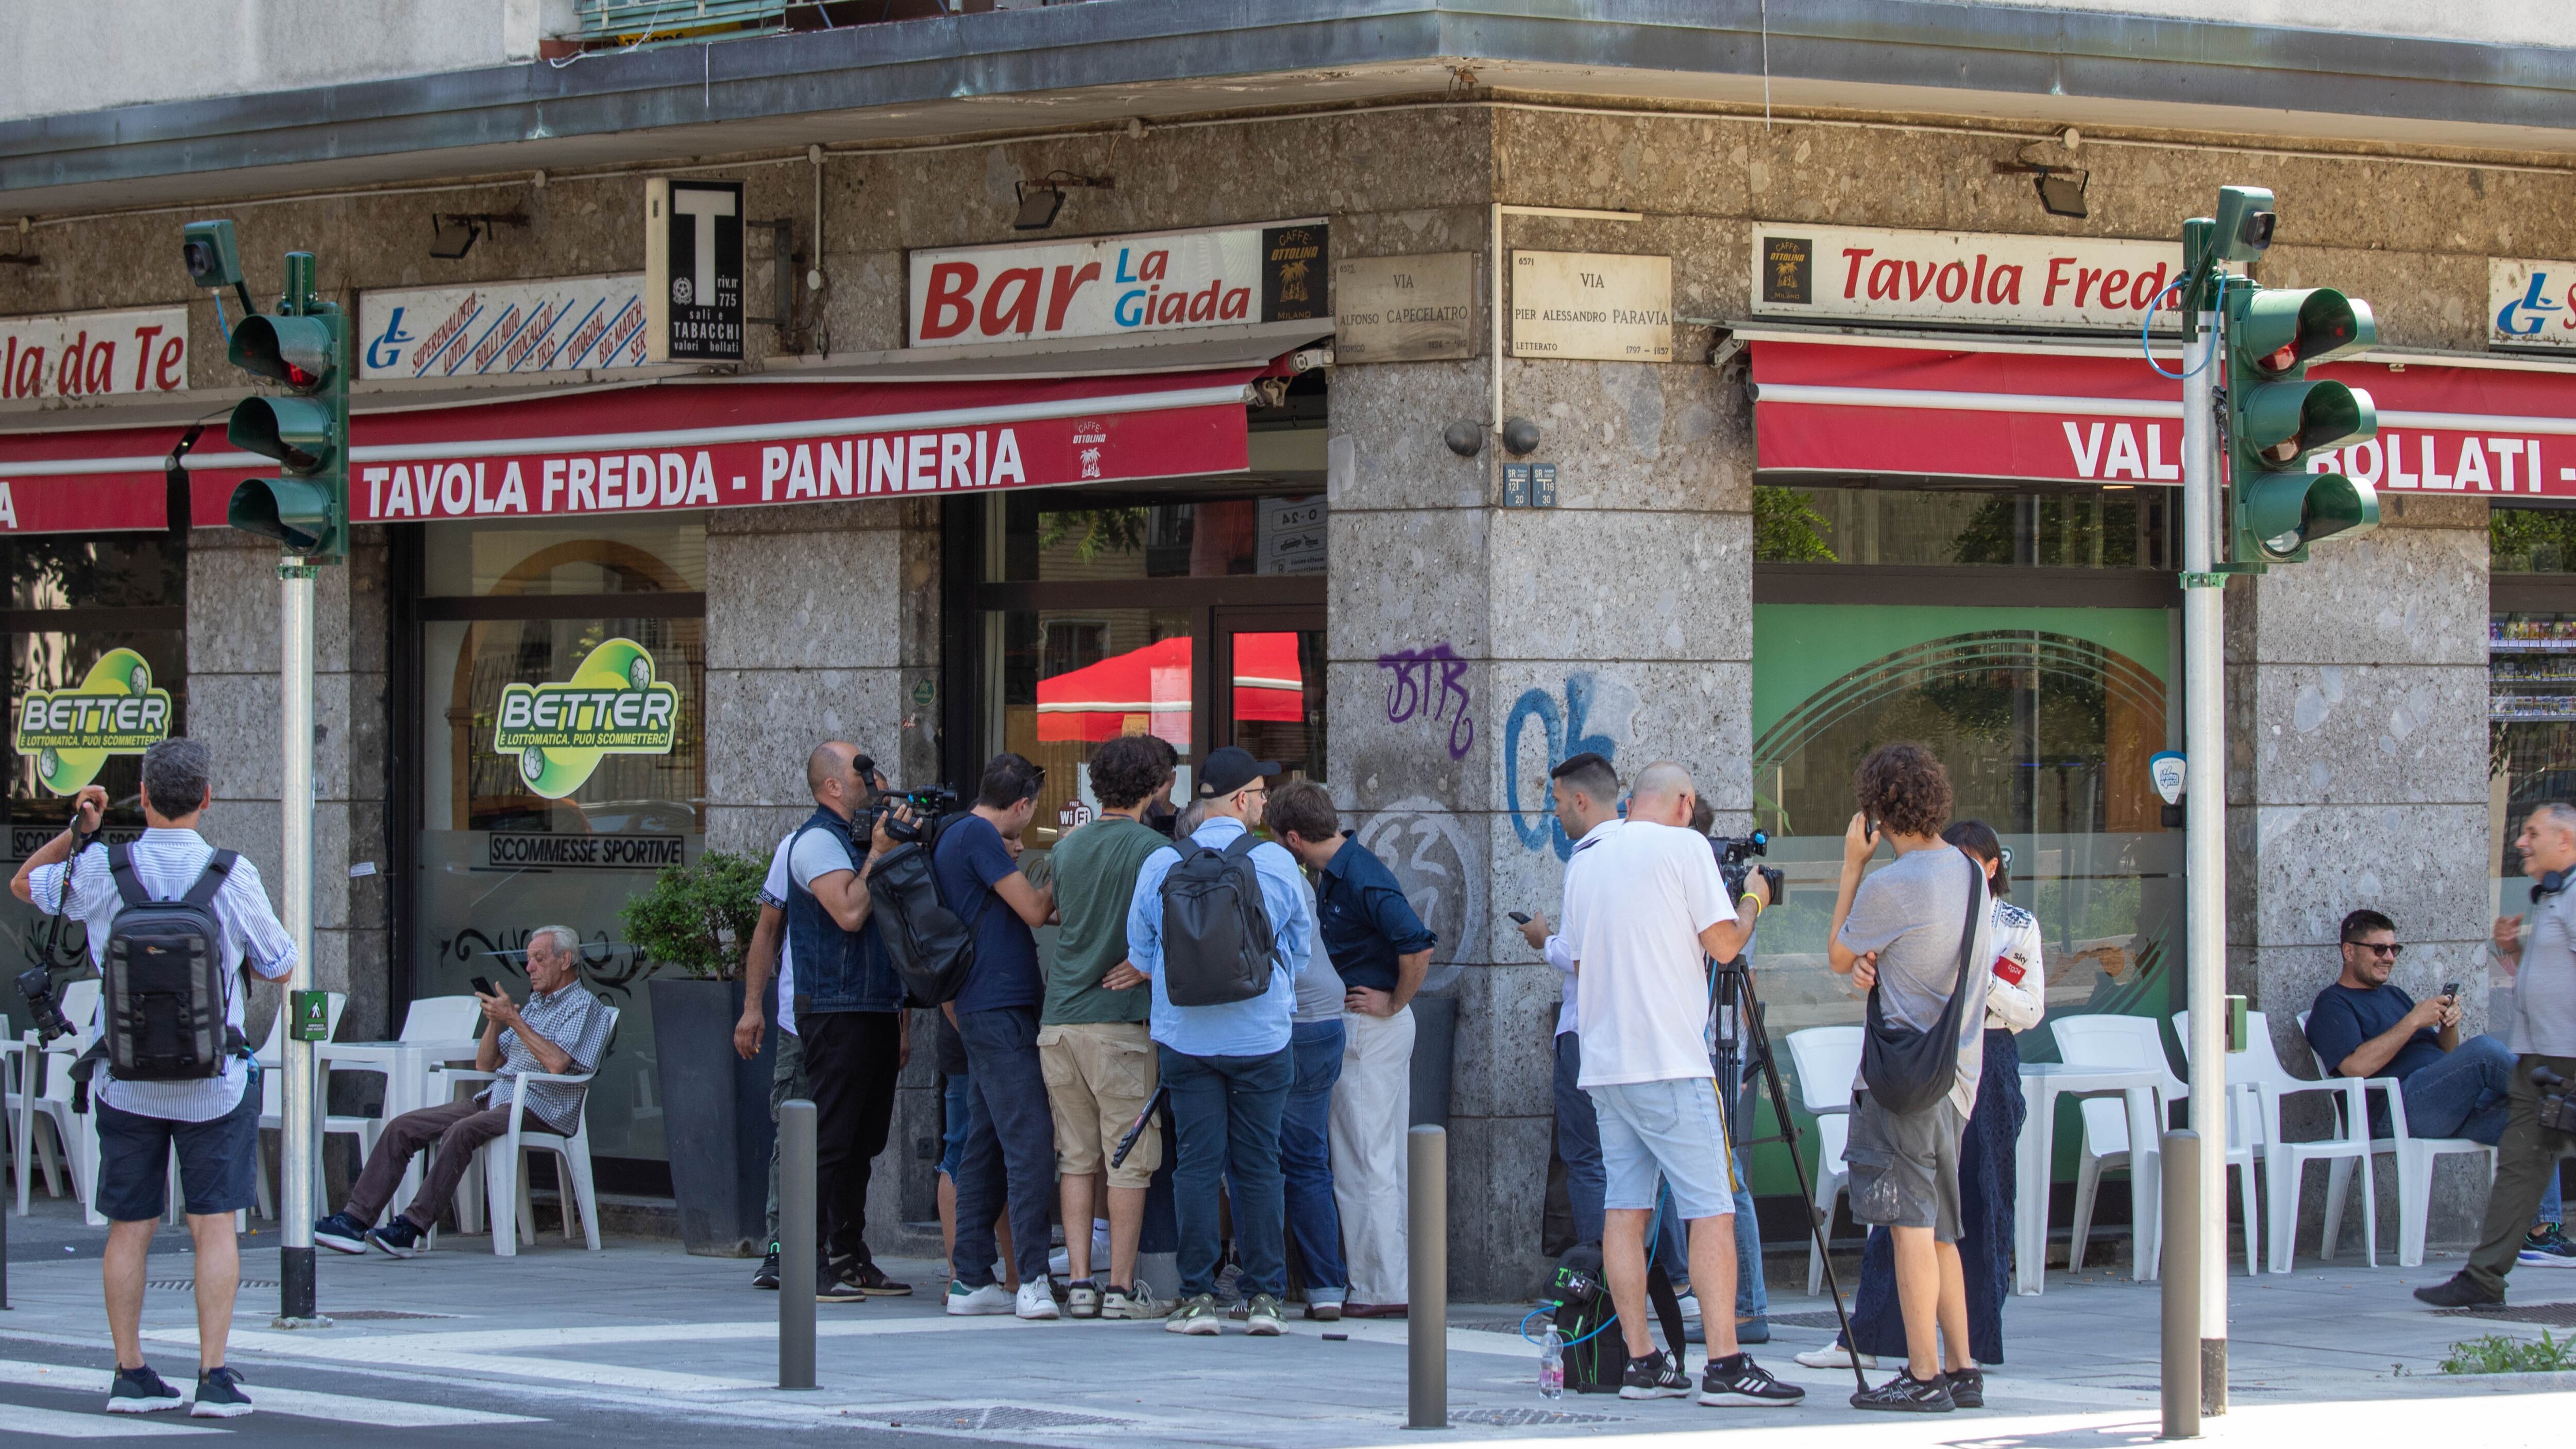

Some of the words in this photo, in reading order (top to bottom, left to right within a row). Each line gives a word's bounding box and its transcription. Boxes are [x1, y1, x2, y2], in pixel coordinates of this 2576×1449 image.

[674, 190, 736, 306] T
[1271, 246, 1318, 260] OTTOLINA
[1770, 251, 1805, 262] OTTOLINA
[1115, 247, 1169, 283] La
[1519, 258, 1534, 266] 6571
[1393, 274, 1414, 289] VIA
[1580, 273, 1605, 289] VIA
[1842, 247, 2024, 305] Tavola
[2042, 257, 2182, 310] Fred
[719, 293, 737, 307] 775
[920, 261, 1101, 340] Bar
[1114, 279, 1251, 327] Giada
[1775, 292, 1800, 300] MILANO
[689, 308, 710, 320] sali
[718, 312, 723, 320] e
[1278, 310, 1311, 319] MILANO
[1340, 313, 1380, 326] ALFONSO
[1387, 306, 1468, 323] CAPECELATRO
[1515, 308, 1537, 320] PIER
[1543, 310, 1606, 322] ALESSANDRO
[1613, 310, 1669, 326] PARAVIA
[412, 291, 477, 375] SUPERENALOTTO
[474, 332, 499, 371] BOLLI
[501, 308, 520, 341] AUTO
[506, 304, 553, 370] TOTOCALCIO
[567, 311, 606, 366] TOTOGOAL
[599, 336, 613, 366] BIG
[615, 300, 642, 342] MATCH
[674, 322, 739, 340] TABACCHI
[443, 334, 469, 374] LOTTO
[537, 332, 556, 369] TRIS
[674, 340, 699, 352] valori
[710, 341, 739, 353] bollati
[1516, 342, 1558, 351] LETTERATO
[1626, 346, 1641, 354] 1797
[0, 336, 45, 398] la
[58, 331, 116, 396] da
[135, 325, 184, 390] Te
[1073, 434, 1106, 444] OTTOLINA
[363, 461, 528, 518] TAVOLA
[542, 451, 718, 513] FREDDA
[761, 428, 1026, 501] PANINERIA
[1508, 469, 1516, 478] SR
[1535, 469, 1543, 478] SR
[1515, 495, 1524, 504] 20
[1543, 495, 1551, 504] 30
[23, 698, 166, 730] BETTER
[503, 692, 672, 728] BETTER
[27, 735, 79, 746] LOTTOMATICA.
[82, 736, 101, 746] PUOI
[507, 732, 570, 745] LOTTOMATICA.
[572, 733, 595, 745] PUOI
[597, 732, 668, 745] SCOMMETTERCI
[493, 838, 597, 863] SCOMMESSE
[603, 839, 682, 865] SPORTIVE
[65, 848, 75, 879] SONY
[761, 890, 773, 902] YORK
[2013, 952, 2028, 966] sky
[2008, 964, 2021, 975] tg24
